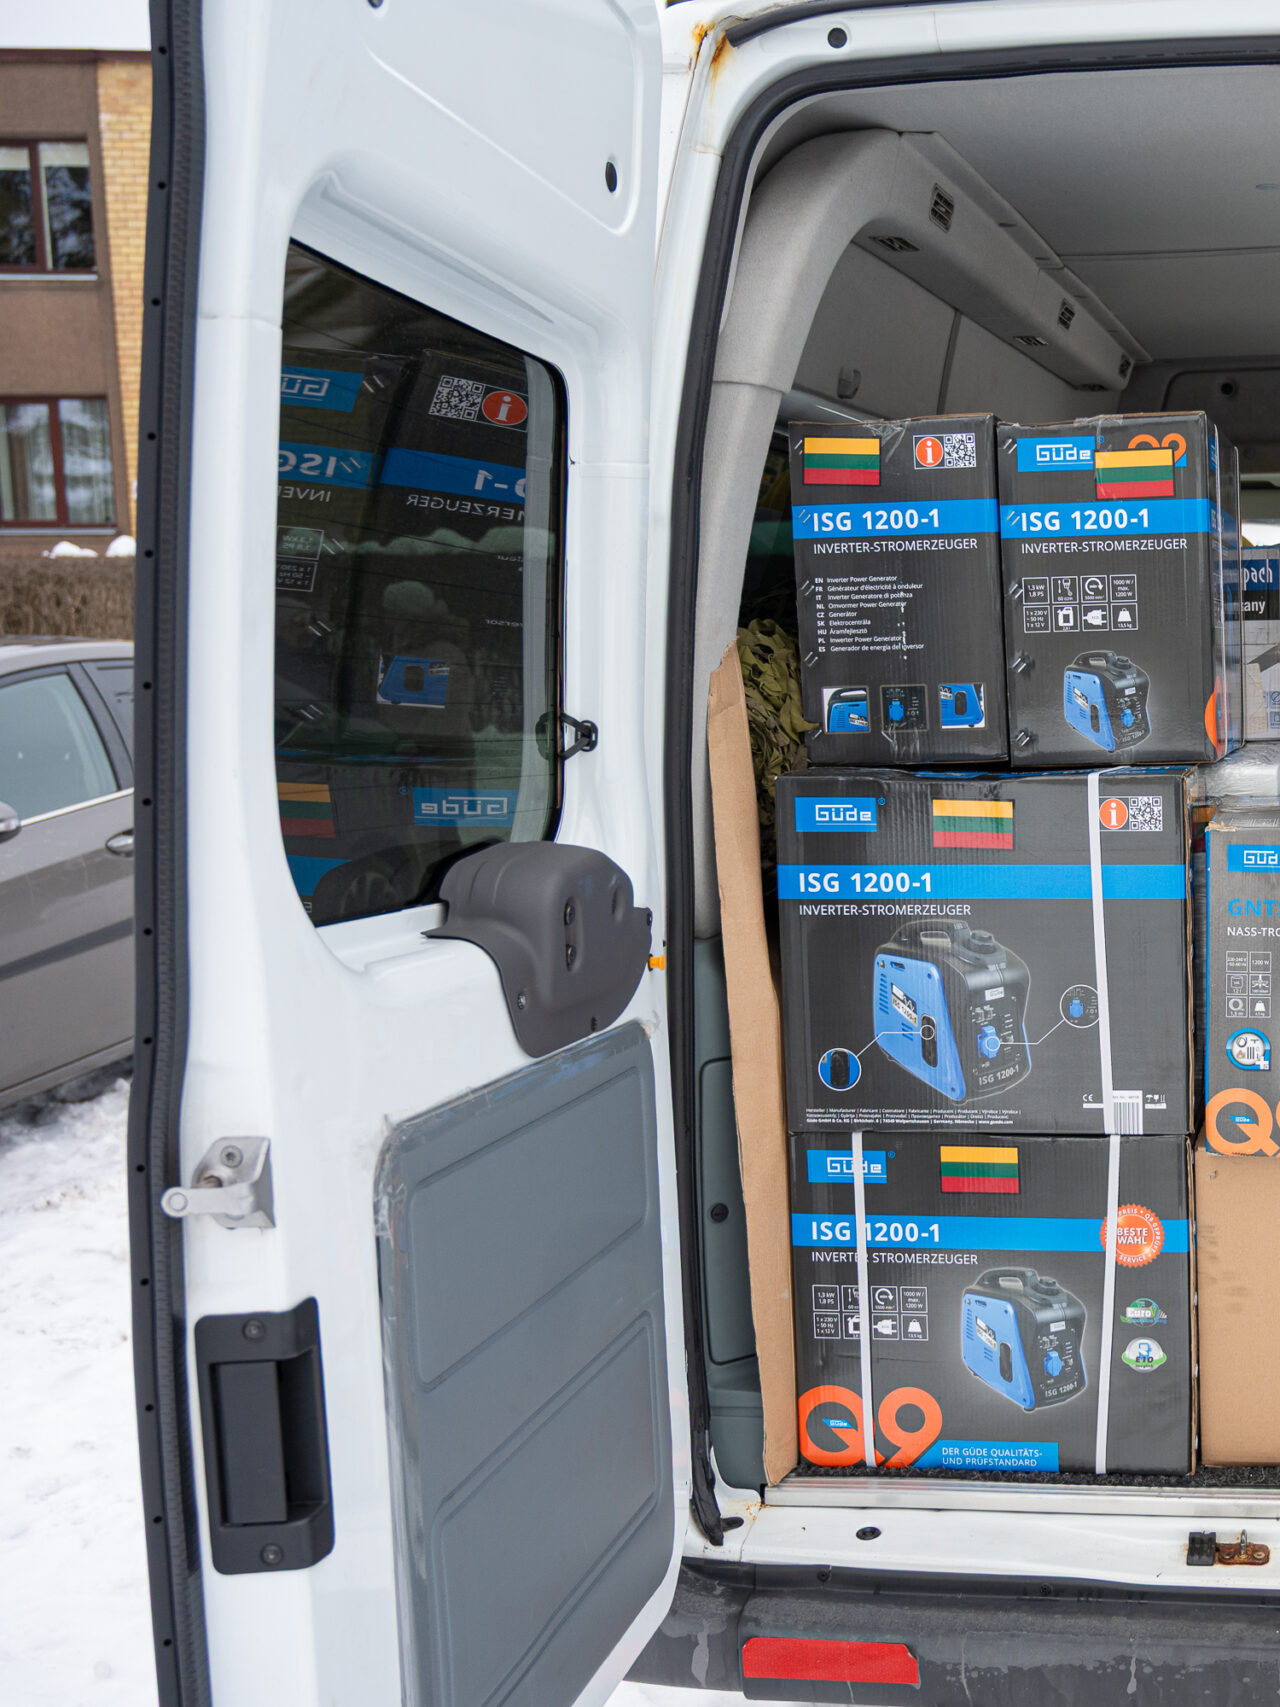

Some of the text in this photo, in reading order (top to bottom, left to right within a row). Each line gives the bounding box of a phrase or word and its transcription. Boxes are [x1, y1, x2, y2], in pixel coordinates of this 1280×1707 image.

[1036, 444, 1091, 462] Güde
[813, 509, 939, 531] ISG 1200-1
[1021, 508, 1149, 531] ISG 1200-1
[814, 538, 978, 554] INVERTER-STROMERZEUGER
[1021, 538, 1187, 554] INVERTER-STROMERZEUGER
[815, 804, 871, 822] Güde
[800, 872, 932, 893] ISG 1200-1
[799, 904, 971, 916] INVERTER-STROMERZEUGER
[979, 1065, 1019, 1085] ISG 1200-1
[812, 1221, 940, 1242] ISG 1200-1
[1118, 1228, 1148, 1236] BESTE
[1118, 1236, 1147, 1245] WAHL
[1045, 1388, 1058, 1397] ISG
[942, 1447, 1043, 1458] DER GÜDE QUALITÄTS-
[942, 1457, 1037, 1466] UND PRÜFSTANDARD
